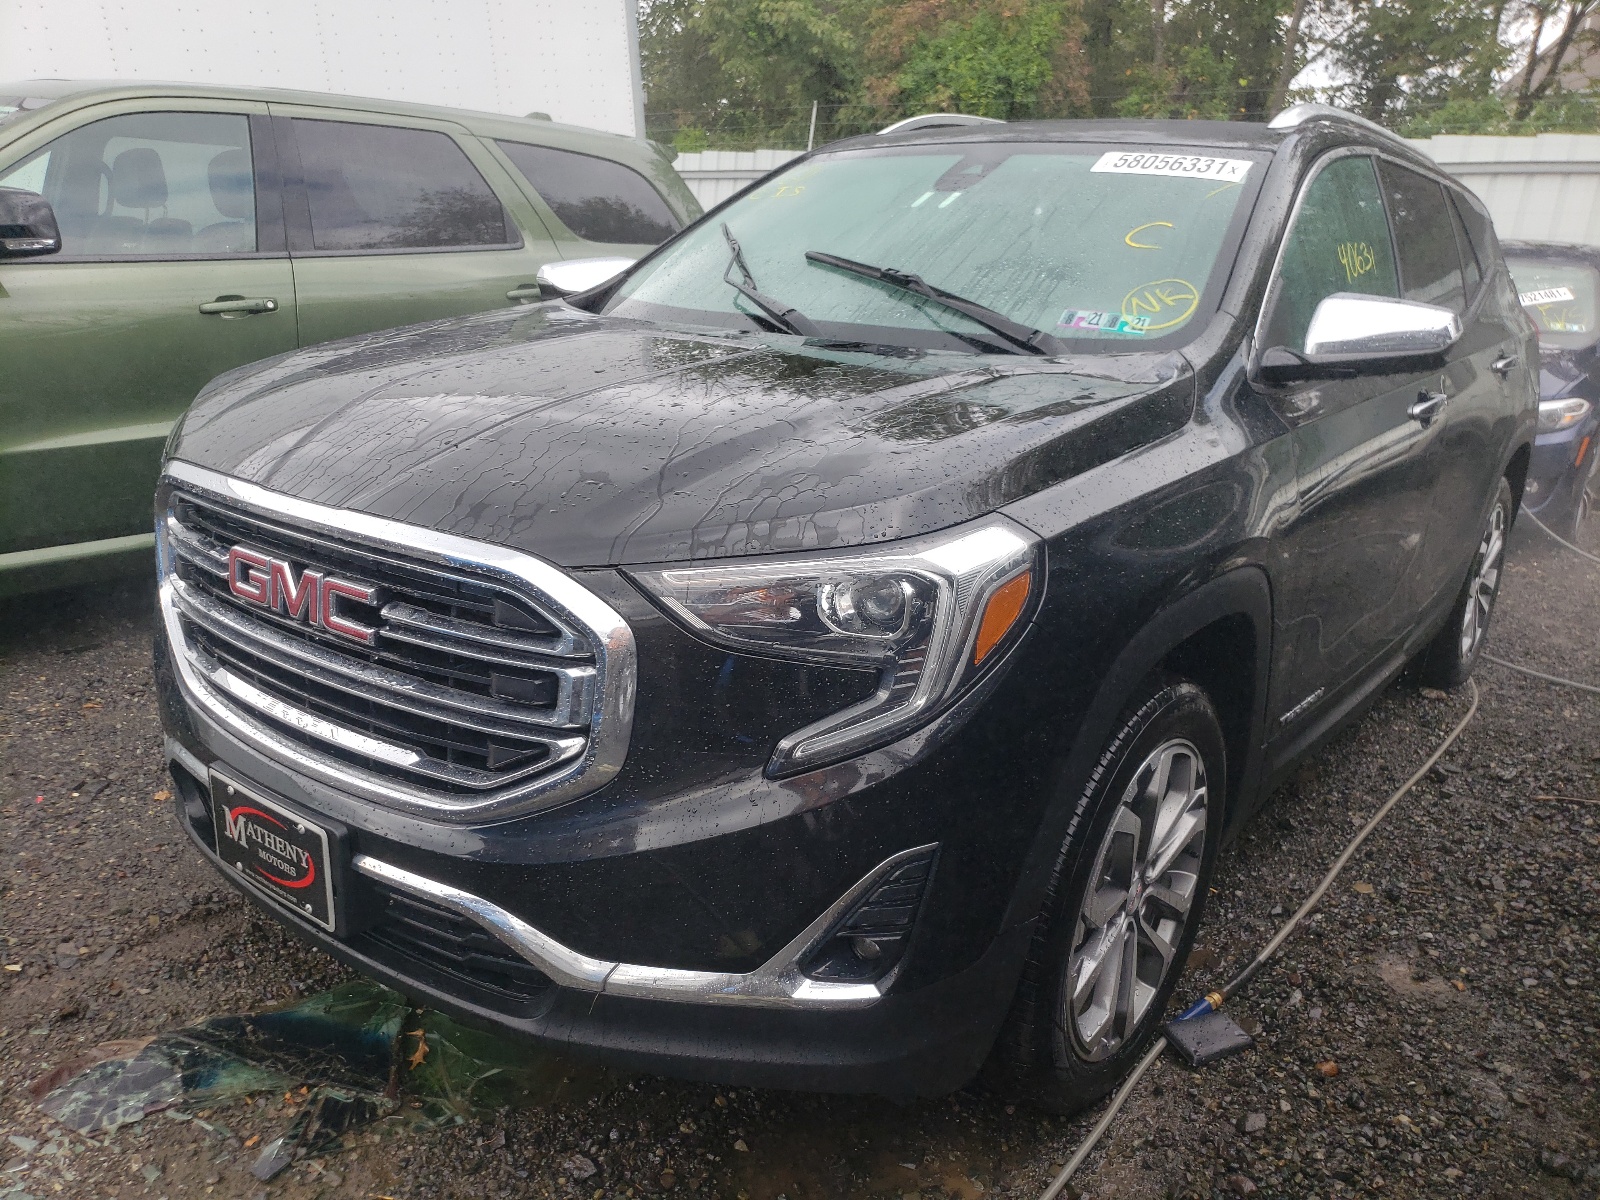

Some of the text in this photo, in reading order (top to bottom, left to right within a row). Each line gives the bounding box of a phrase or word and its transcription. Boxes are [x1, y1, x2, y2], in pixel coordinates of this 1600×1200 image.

[1088, 311, 1103, 326] 21
[228, 544, 378, 646] GMC
[221, 804, 310, 869] MATHENY
[257, 848, 297, 877] MOTORS
